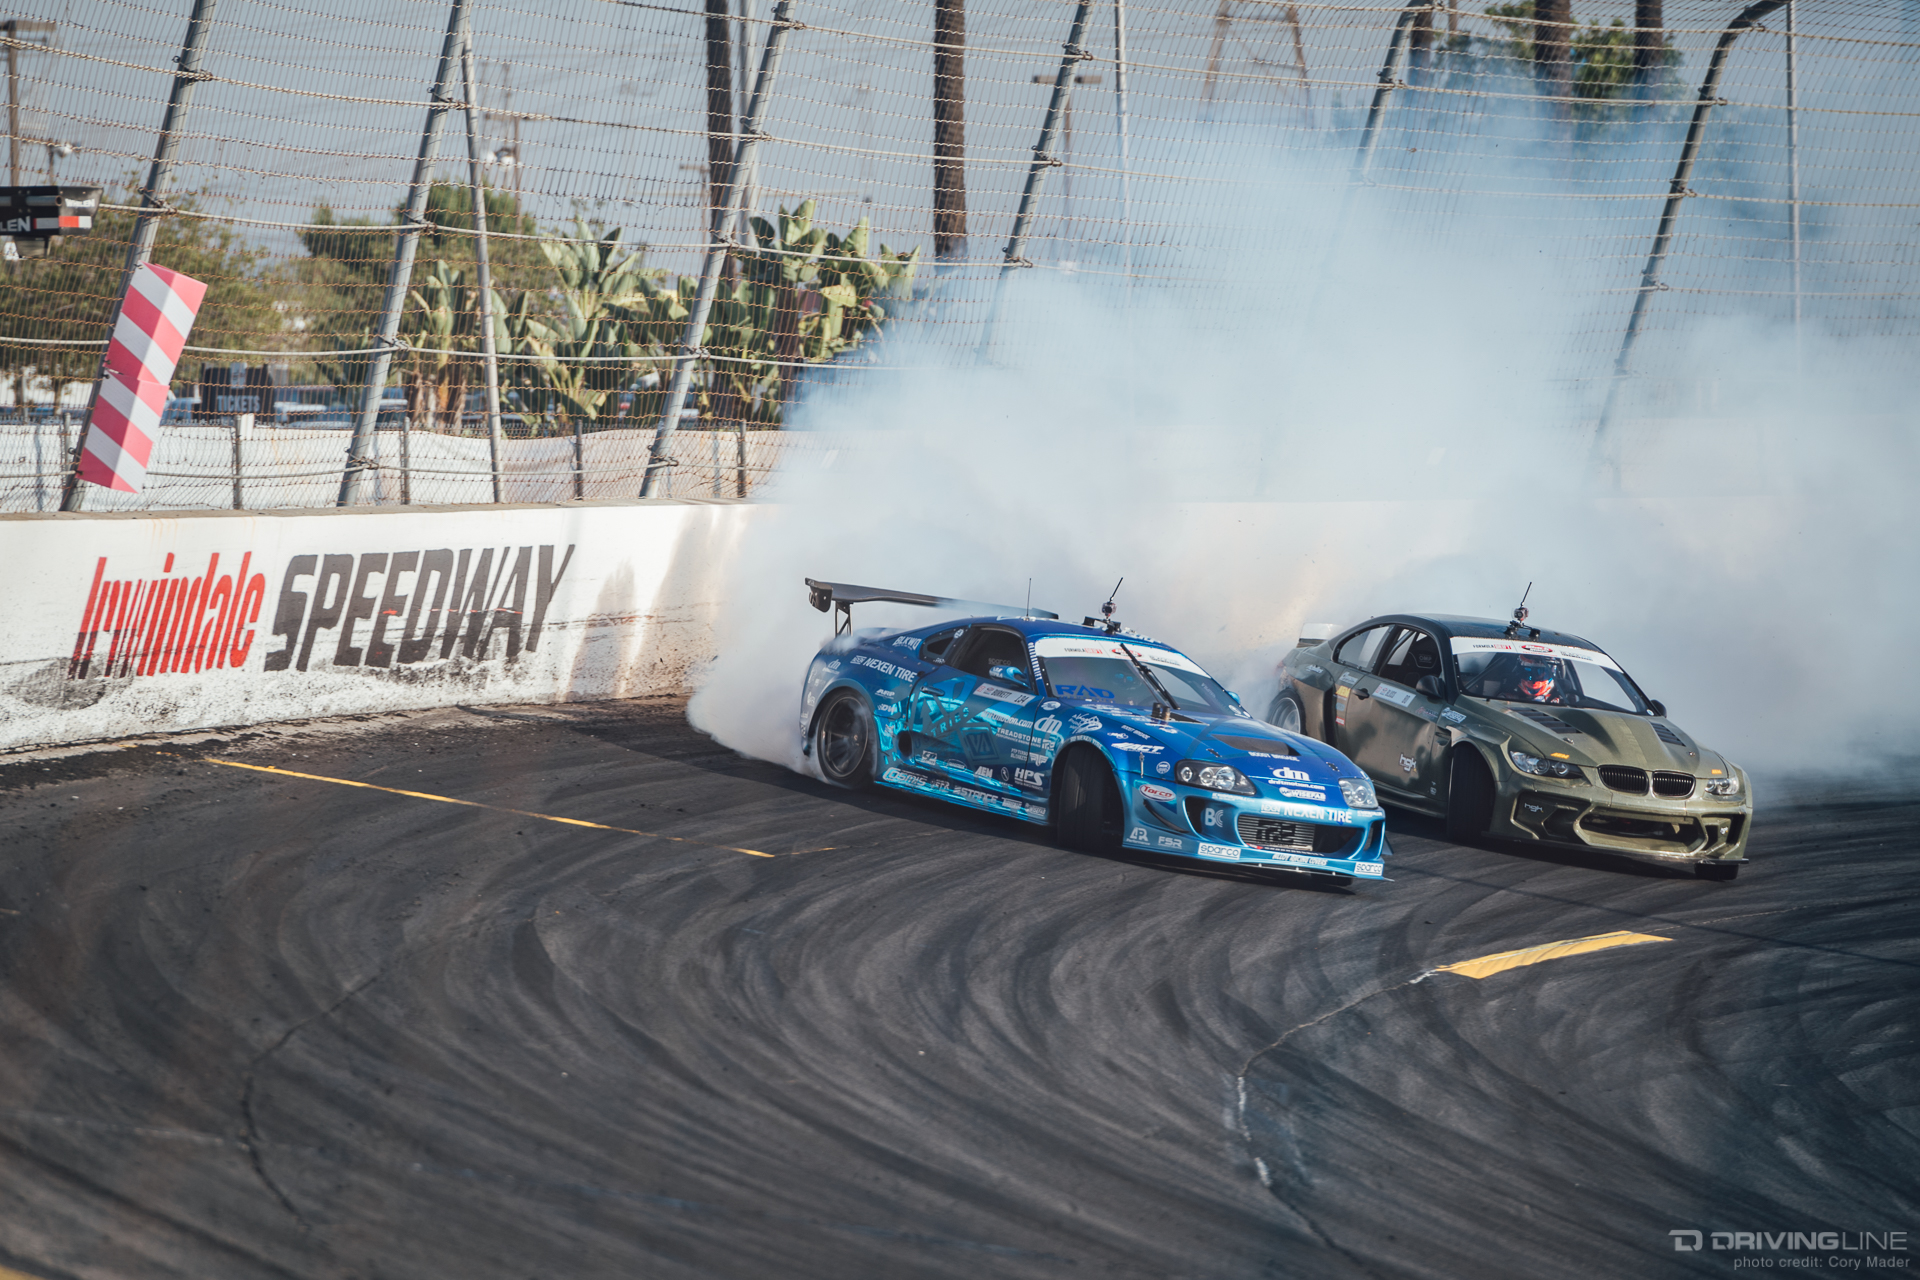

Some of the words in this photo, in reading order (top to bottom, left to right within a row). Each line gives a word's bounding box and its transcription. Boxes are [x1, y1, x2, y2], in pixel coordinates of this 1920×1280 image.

[217, 395, 260, 412] TICKETS
[68, 551, 266, 679] Irwindale
[264, 544, 576, 672] SPEEDWAY
[863, 657, 896, 676] NEXEN
[894, 666, 917, 682] TIRE
[988, 658, 1011, 667] sparco
[1055, 684, 1115, 699] RAD
[1034, 714, 1062, 734] dm
[997, 727, 1042, 743] TREADSTONE
[1014, 767, 1045, 787] HPS
[1272, 767, 1311, 781] dm
[1143, 785, 1173, 799] Torco
[1268, 779, 1326, 790] driftmotion.com
[1283, 807, 1325, 820] NEXEN
[1327, 809, 1352, 824] TIRE
[1200, 844, 1239, 857] sparco
[1356, 862, 1383, 873] sparco
